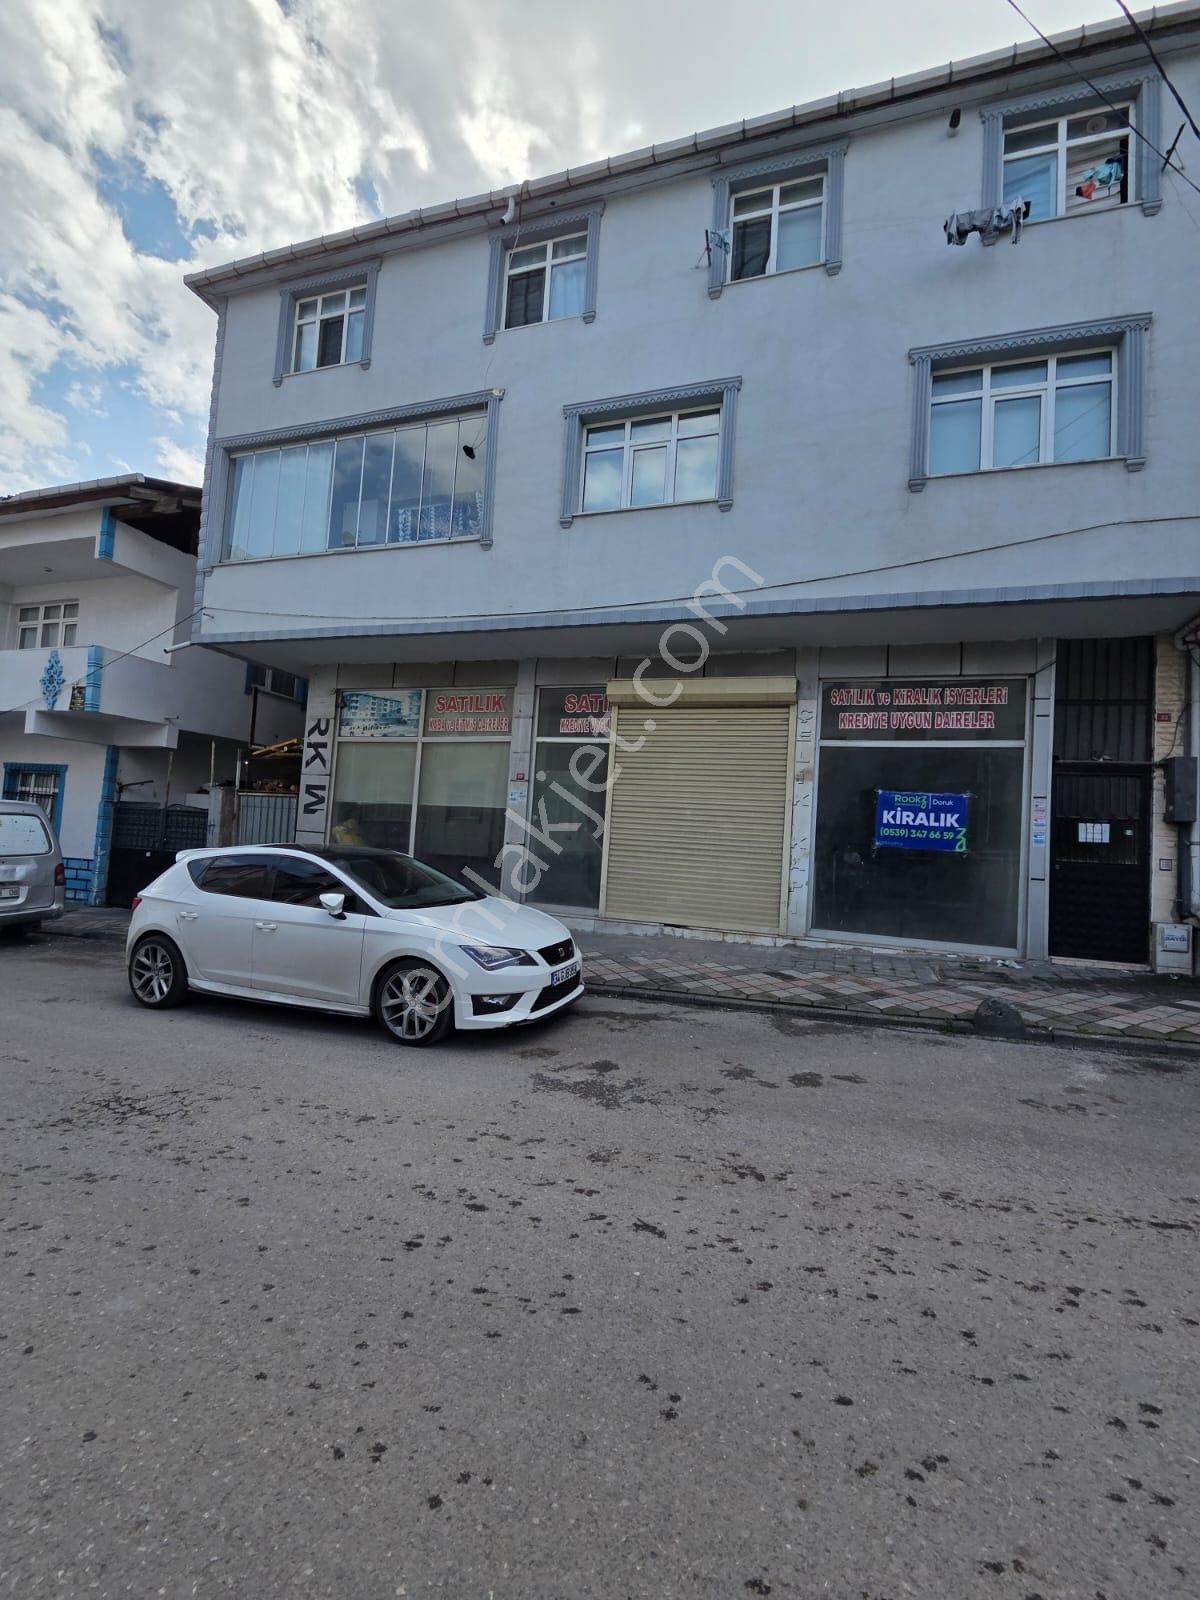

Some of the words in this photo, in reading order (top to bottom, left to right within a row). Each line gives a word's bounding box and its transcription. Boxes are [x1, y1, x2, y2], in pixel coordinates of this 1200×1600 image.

[435, 695, 505, 713] SATILIK
[831, 689, 875, 705] SATILIK
[877, 692, 890, 704] ve
[893, 688, 942, 705] KİRALIK
[839, 712, 888, 729] KREDİYE
[891, 712, 932, 728] UYGUN
[935, 711, 995, 728] DAİRELER
[932, 798, 954, 806] Doruk
[882, 807, 960, 828] KİRALIK
[880, 827, 909, 838] (0539)
[910, 829, 927, 838] 347
[929, 831, 941, 839] 66
[943, 831, 954, 839] 59
